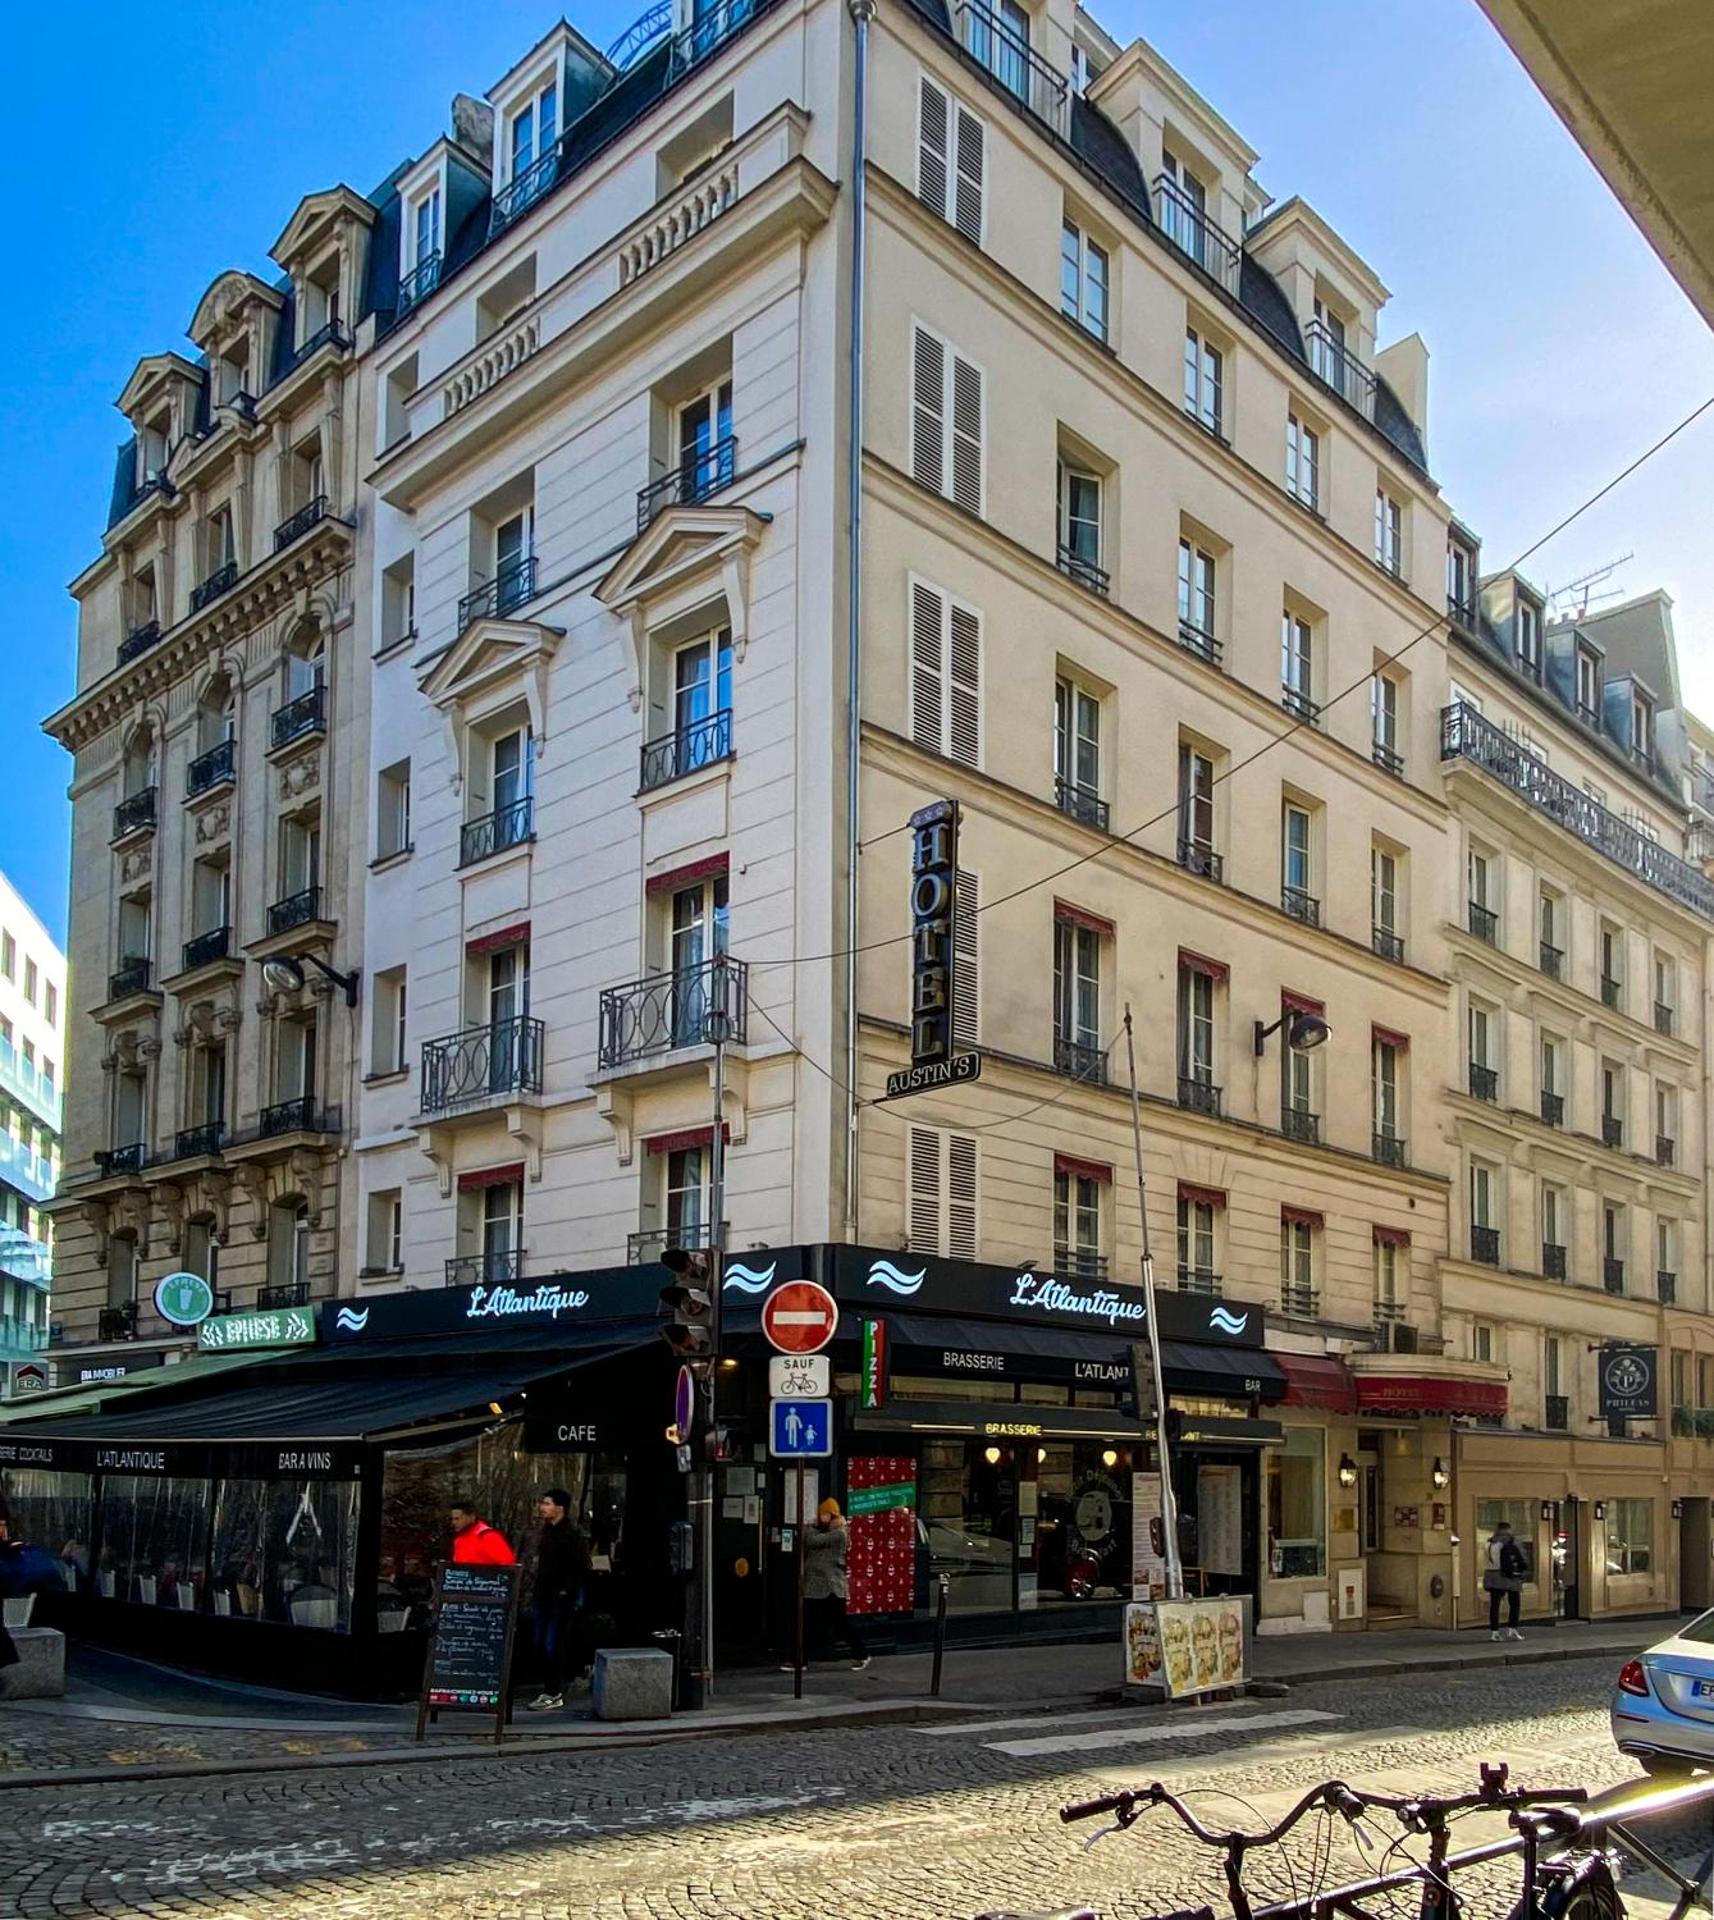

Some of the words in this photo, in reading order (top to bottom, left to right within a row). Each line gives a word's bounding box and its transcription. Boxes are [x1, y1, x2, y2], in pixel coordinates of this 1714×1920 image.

[911, 822, 949, 1058] HOTEL
[888, 1056, 970, 1094] AUSTIN'S
[466, 1285, 590, 1319] L'Atlantique
[1009, 1273, 1147, 1326] L'Atlantique
[783, 1358, 815, 1370] SAUF
[867, 1321, 879, 1407] PIZZA
[943, 1351, 1005, 1371] BRASSERIE
[17, 1379, 42, 1390] ERA
[1245, 1379, 1261, 1392] BAR
[557, 1424, 597, 1442] CAFE
[985, 1422, 1043, 1436] BRASSERIE
[97, 1450, 165, 1470] L'ATLANTIQUE
[278, 1452, 298, 1470] BAR
[307, 1451, 332, 1470] VINS
